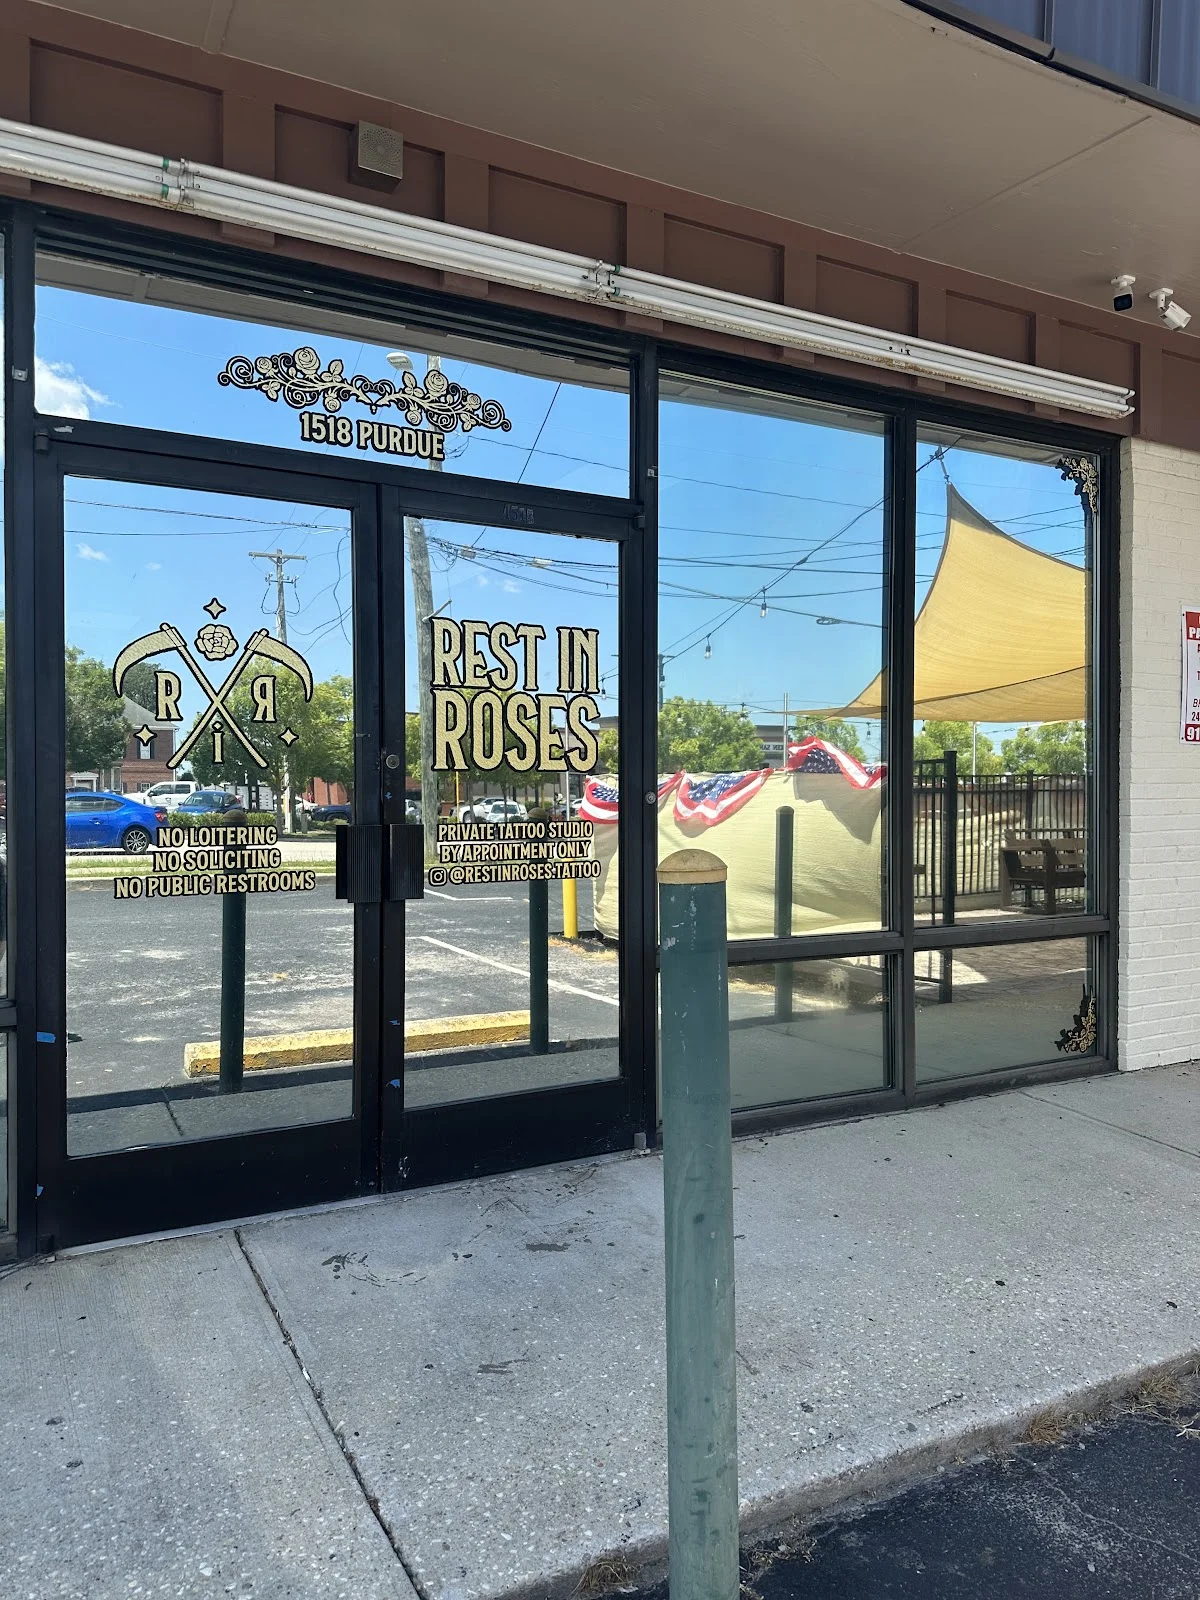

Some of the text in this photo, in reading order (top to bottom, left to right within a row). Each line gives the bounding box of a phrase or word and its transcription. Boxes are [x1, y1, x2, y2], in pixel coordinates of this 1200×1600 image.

[301, 412, 445, 460] 1518 PURDUE
[430, 617, 599, 693] REST IN
[155, 671, 183, 721] R
[430, 688, 600, 773] ROSES
[158, 826, 277, 847] NO LOITERING
[438, 821, 593, 841] PRIVATE TATTOO STUDIO
[154, 849, 281, 871] NO SOLICITING
[440, 841, 590, 862] BY APPOINTMENT ONLY
[115, 871, 315, 898] NO PUBLIC RESTROOMS
